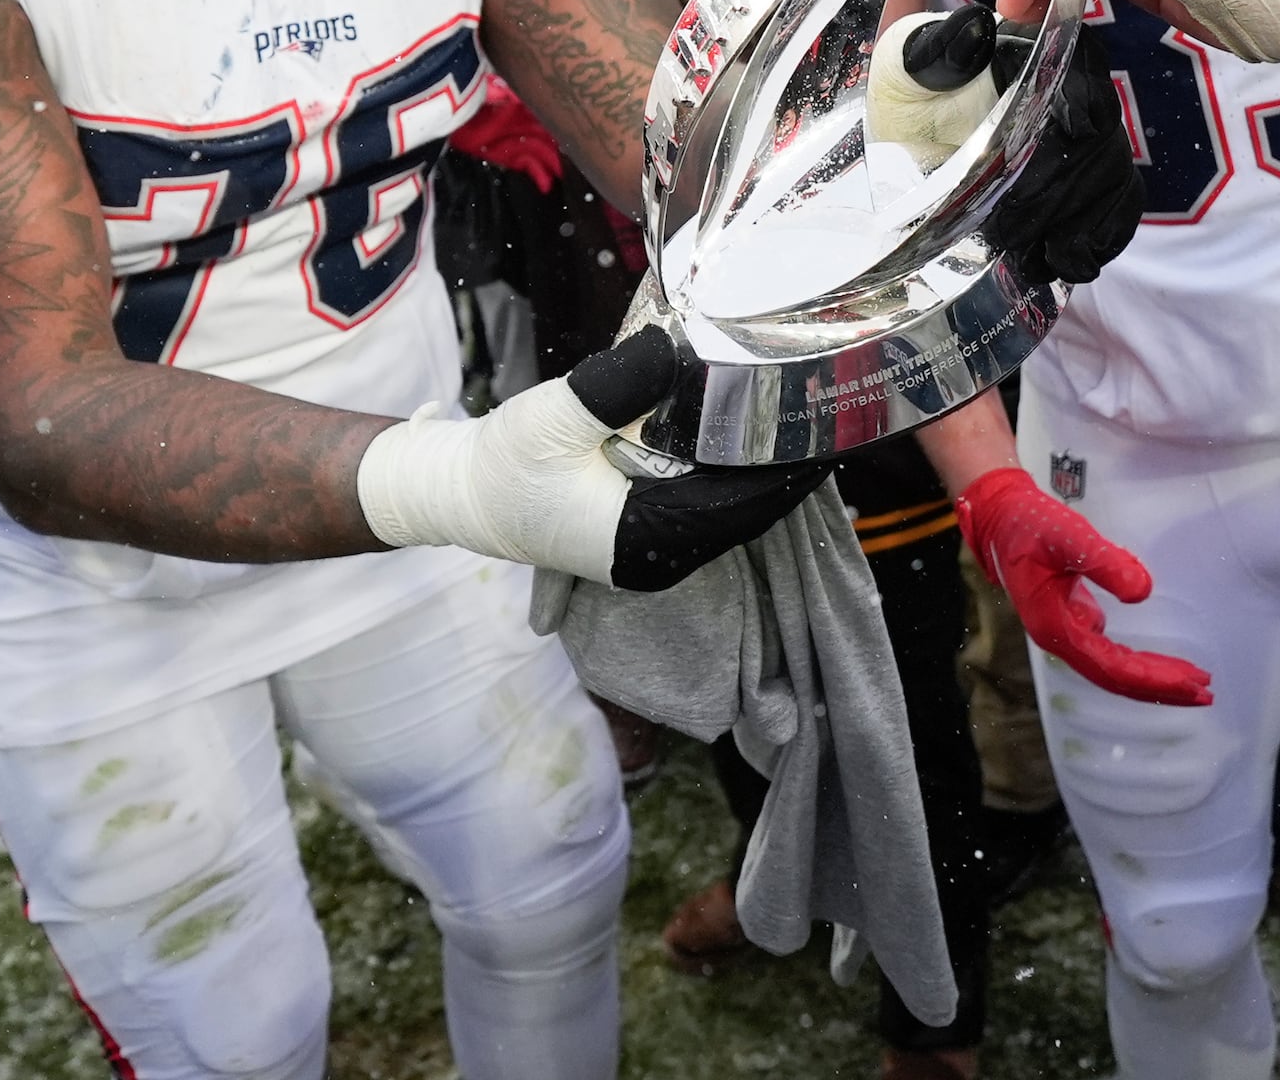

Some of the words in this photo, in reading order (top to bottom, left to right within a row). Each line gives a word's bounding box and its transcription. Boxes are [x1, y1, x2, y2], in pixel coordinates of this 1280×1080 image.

[66, 13, 485, 367] 76
[707, 416, 737, 426] 2025
[821, 389, 892, 417] FOOTBALL
[895, 341, 980, 392] CONFERENCE
[980, 287, 1037, 344] CHAMPIONS
[805, 379, 860, 403] LAMAR
[863, 364, 903, 389] HUNT
[907, 333, 961, 369] TROPHY
